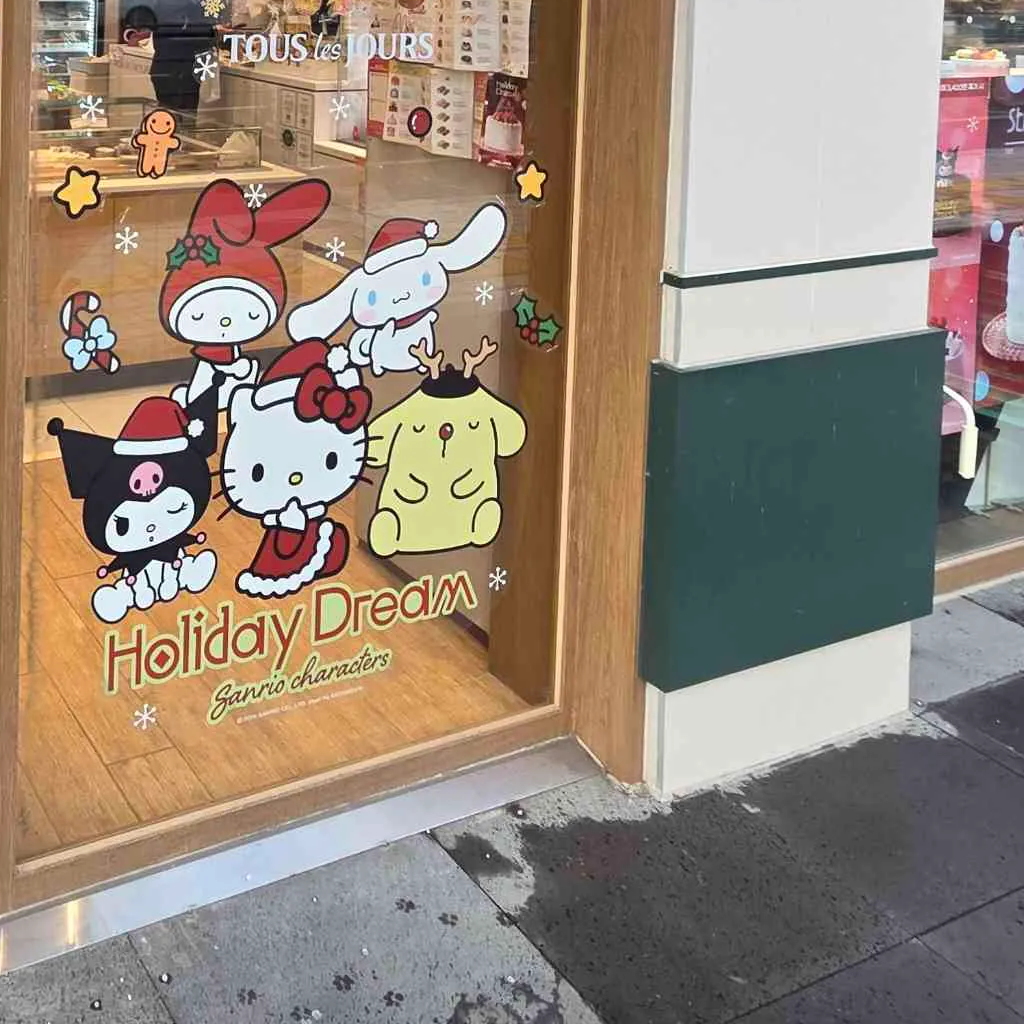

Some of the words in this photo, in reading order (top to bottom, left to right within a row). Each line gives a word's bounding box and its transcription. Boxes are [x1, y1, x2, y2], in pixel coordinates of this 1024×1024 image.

[223, 33, 308, 64] TOUS
[314, 36, 341, 61] les
[344, 32, 433, 66] JOURS
[108, 605, 303, 691] Holiday
[315, 573, 476, 641] Dream
[210, 676, 285, 720] Sanrio
[291, 647, 389, 691] characters
